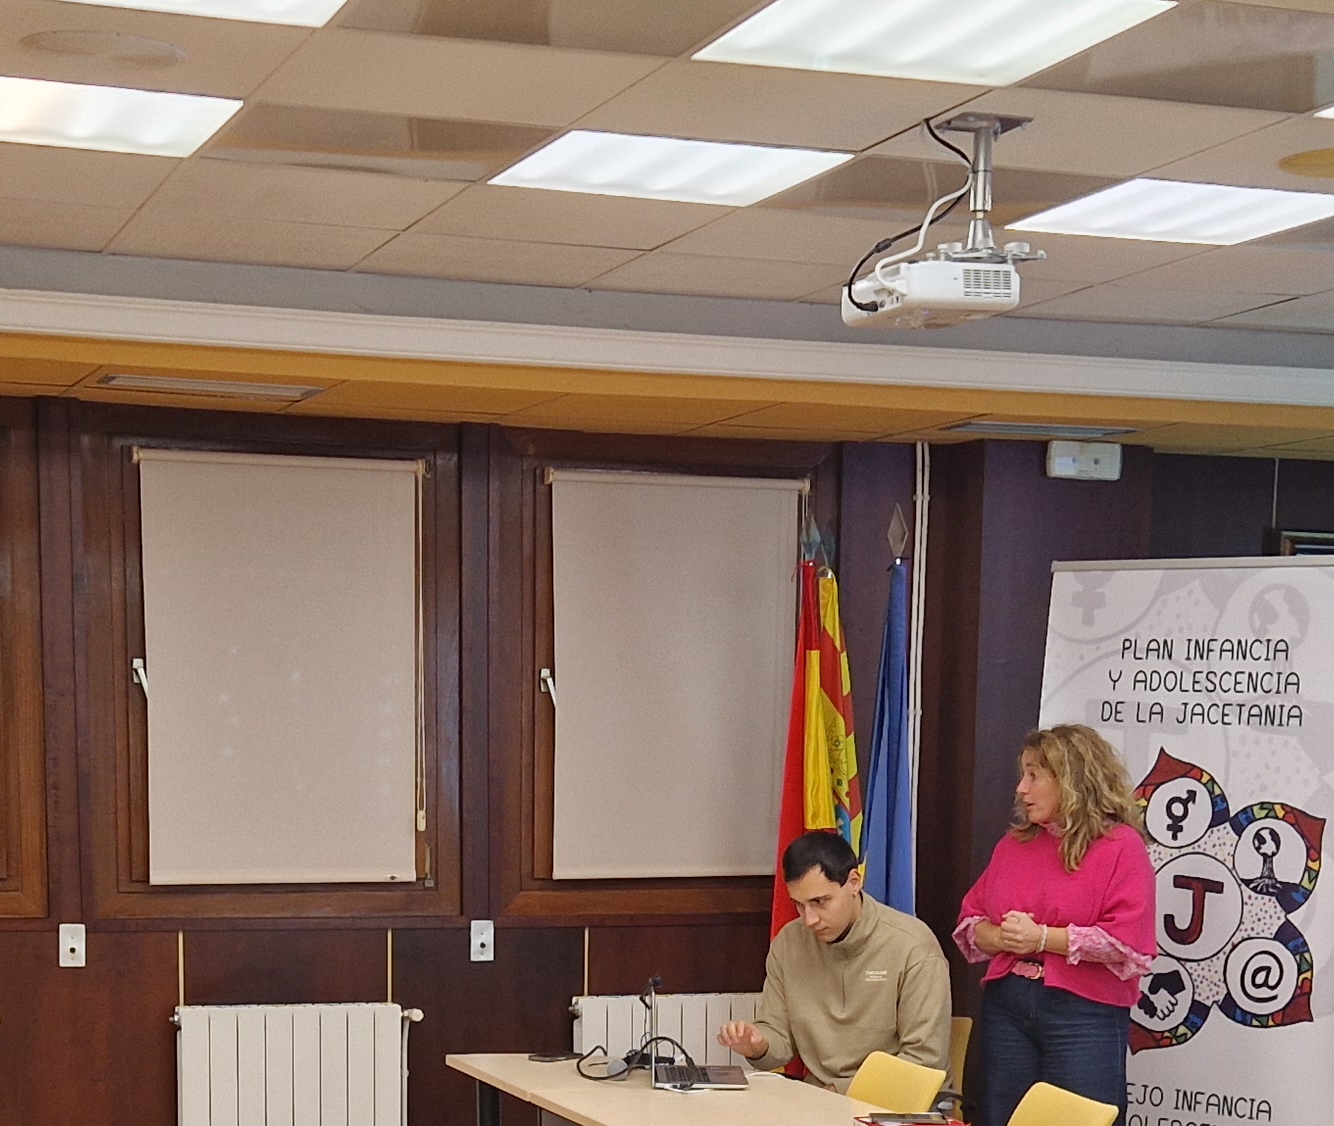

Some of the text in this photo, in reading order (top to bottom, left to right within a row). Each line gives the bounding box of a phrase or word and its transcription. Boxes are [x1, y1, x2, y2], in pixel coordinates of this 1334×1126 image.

[1121, 638, 1290, 661] PLAN INFANCIA
[1108, 669, 1301, 694] Y ADOLESCENCIA
[1100, 701, 1303, 727] DE LA JACETANIA
[1126, 1082, 1272, 1122] EJO INFANCIA
